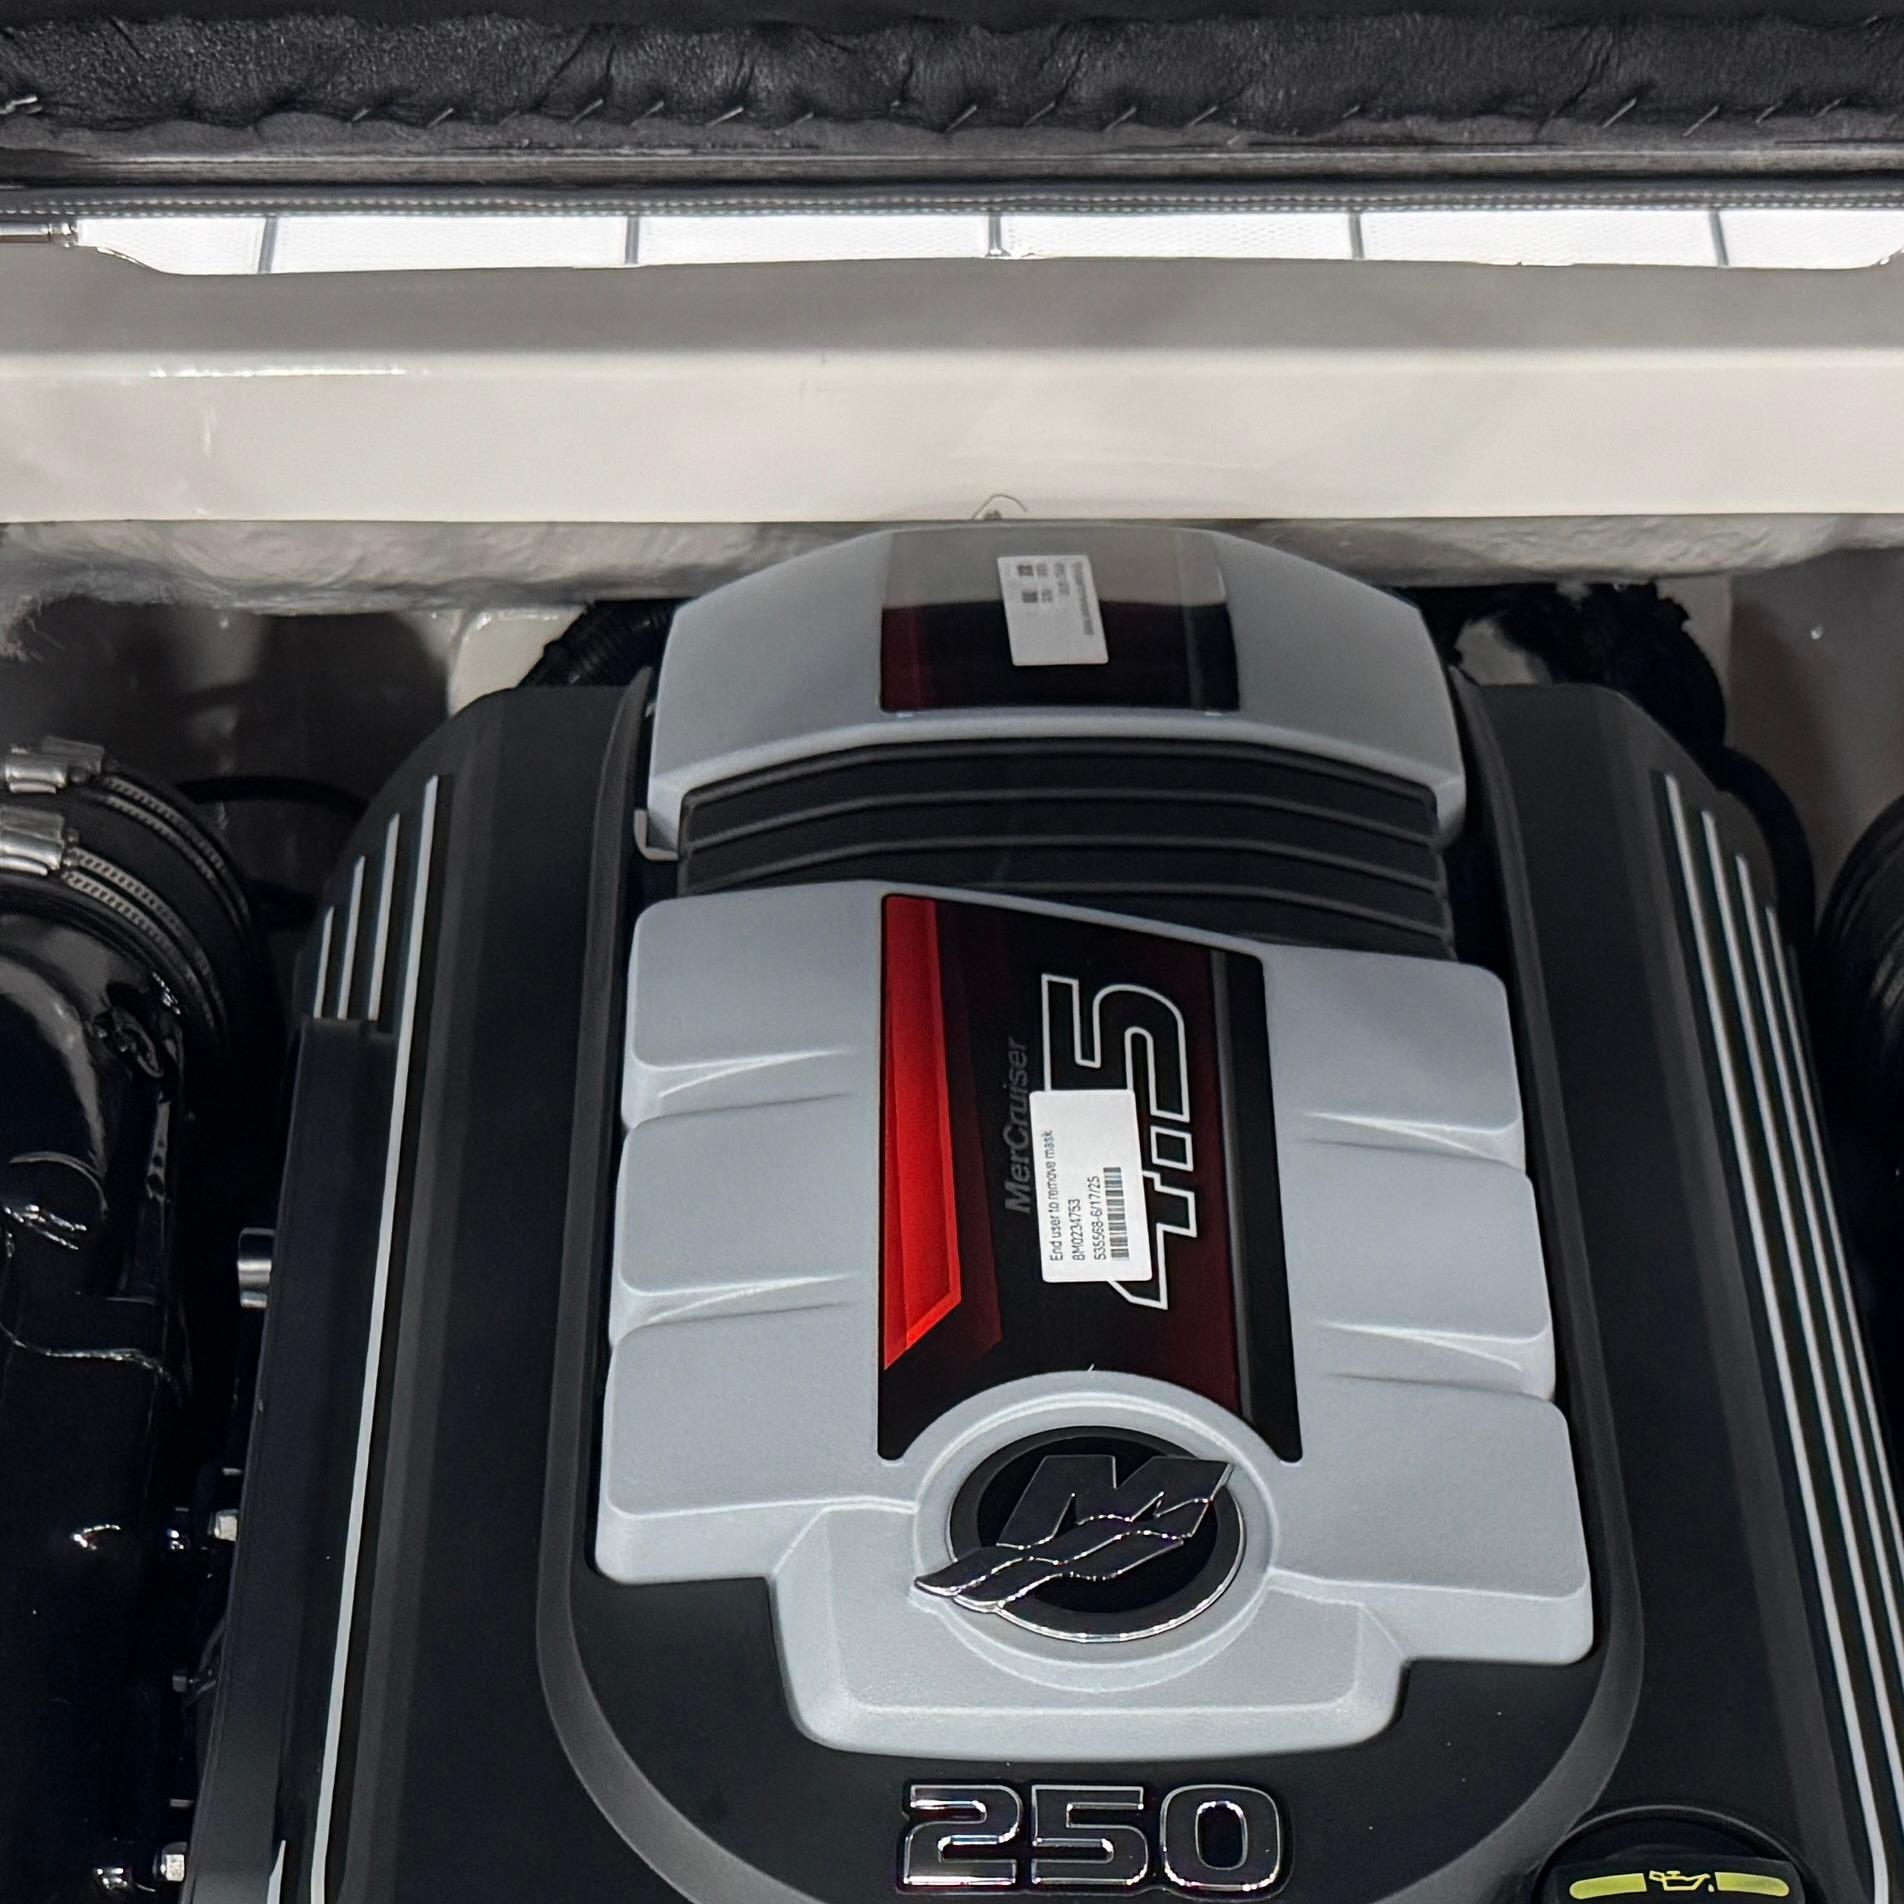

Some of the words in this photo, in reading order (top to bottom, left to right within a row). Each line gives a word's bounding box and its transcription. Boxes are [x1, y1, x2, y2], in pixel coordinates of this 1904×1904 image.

[1004, 1036, 1031, 1214] MerCruiser
[1041, 1130, 1055, 1159] mask
[1045, 1162, 1060, 1200] remove
[1047, 1203, 1060, 1213] to
[1048, 1216, 1062, 1237] user
[1049, 1241, 1064, 1262] End
[901, 1780, 1289, 1897] 250
